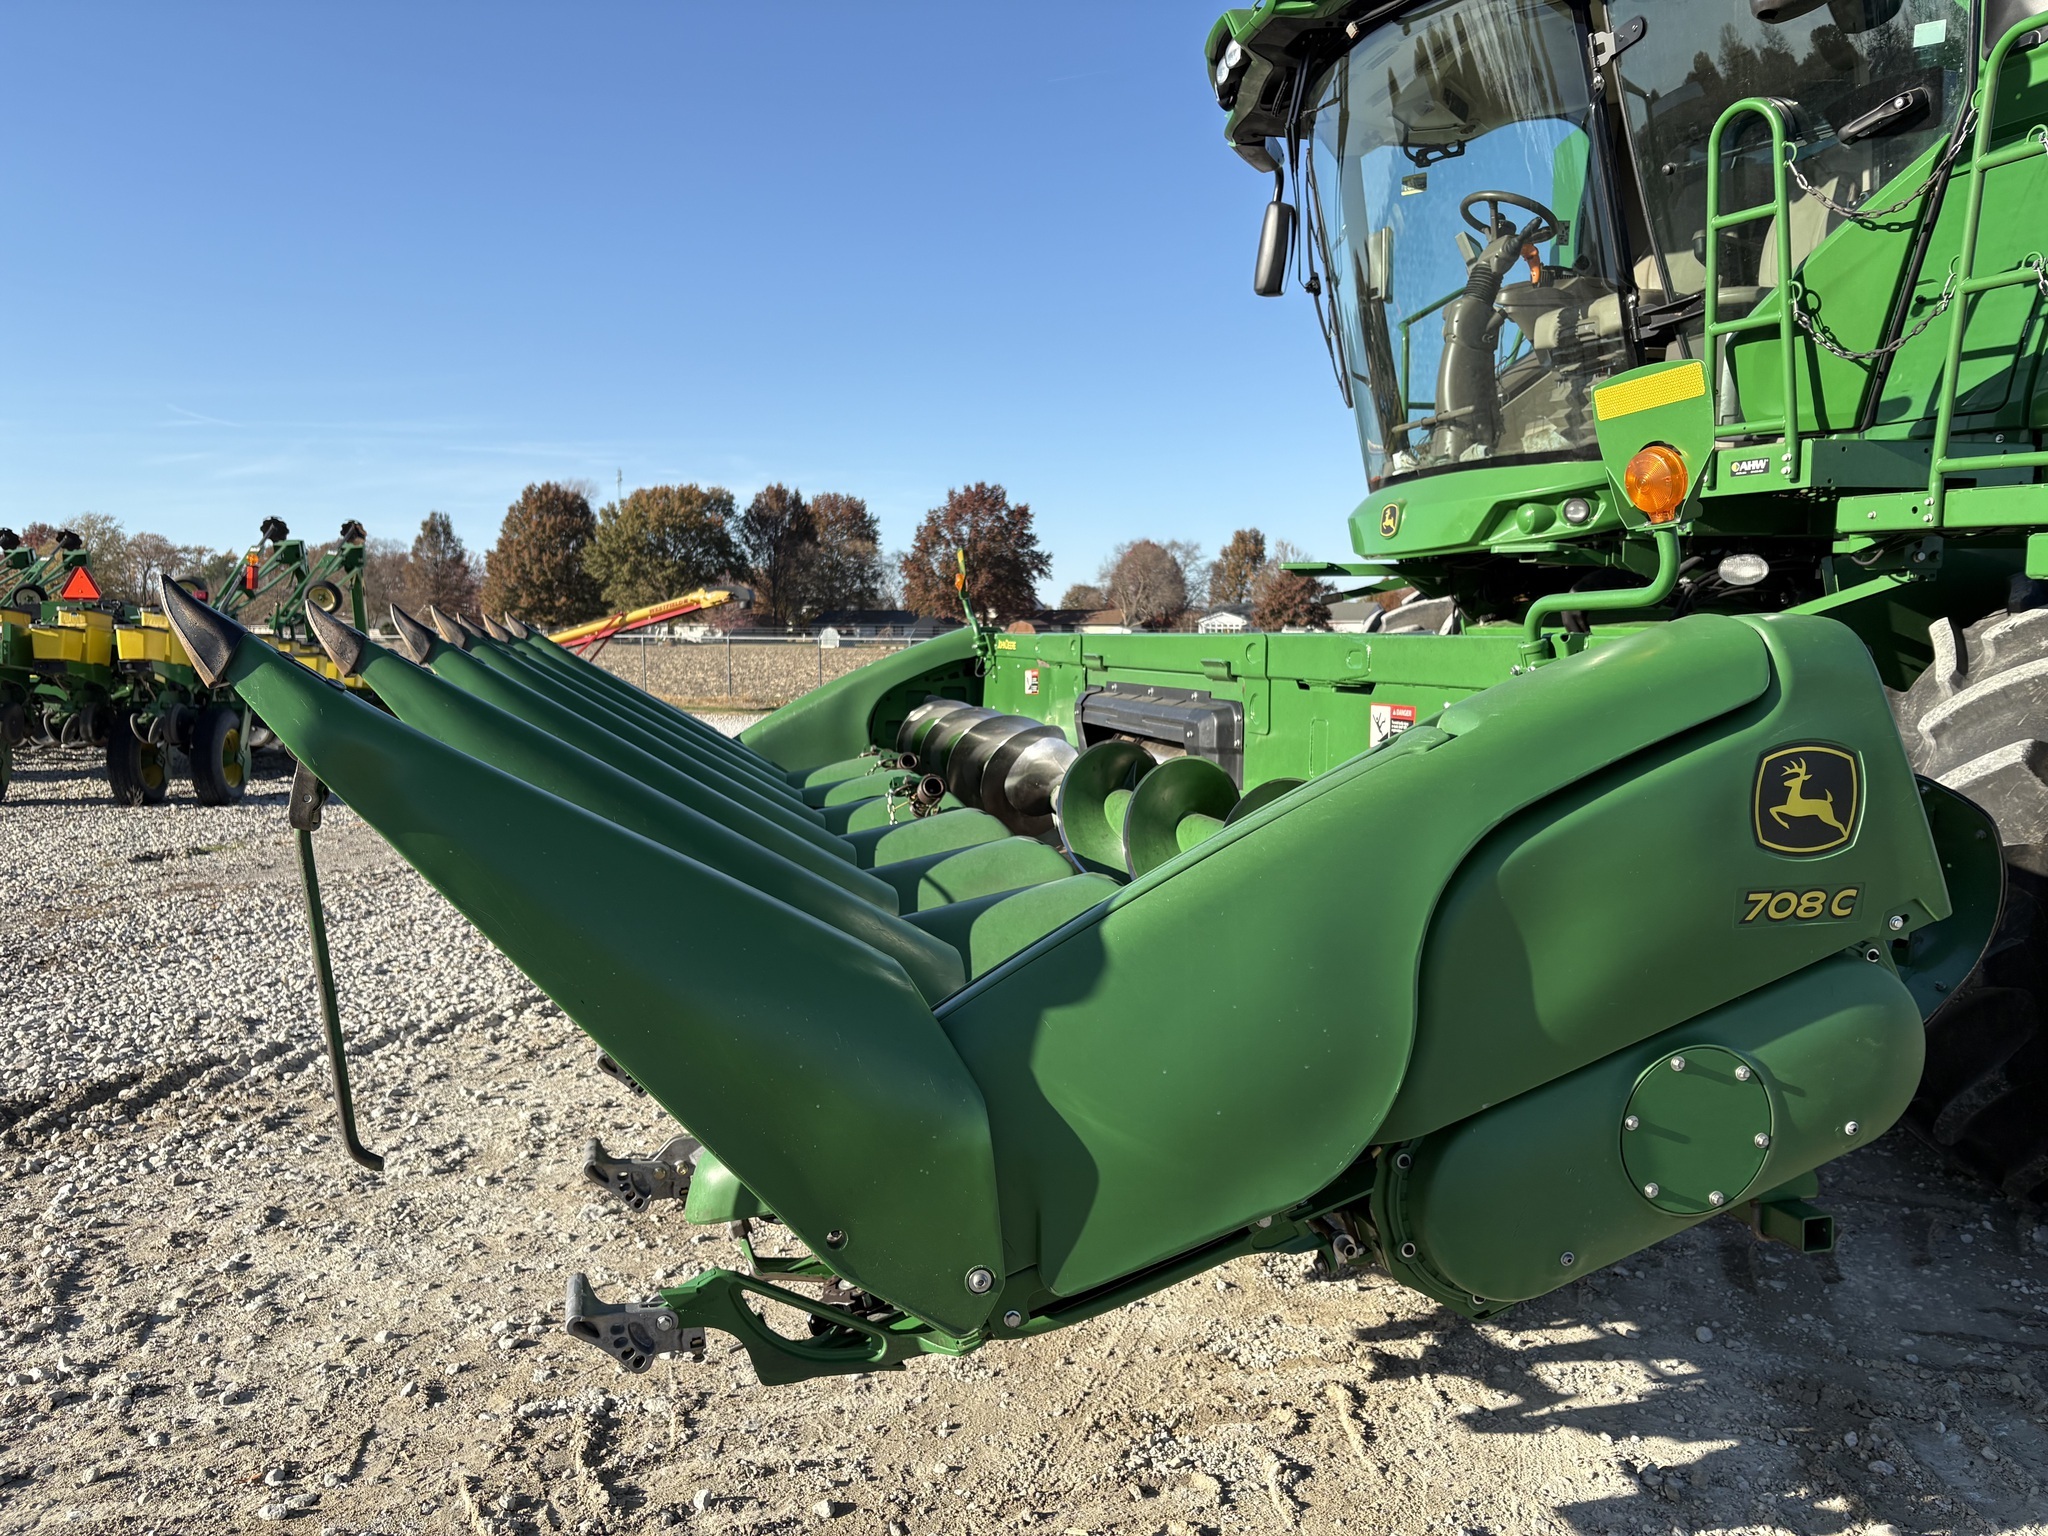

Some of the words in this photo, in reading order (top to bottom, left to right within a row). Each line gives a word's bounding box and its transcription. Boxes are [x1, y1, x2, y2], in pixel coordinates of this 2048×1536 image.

[1739, 459, 1767, 471] AHW
[1742, 890, 1827, 921] 708
[1831, 888, 1858, 917] C
